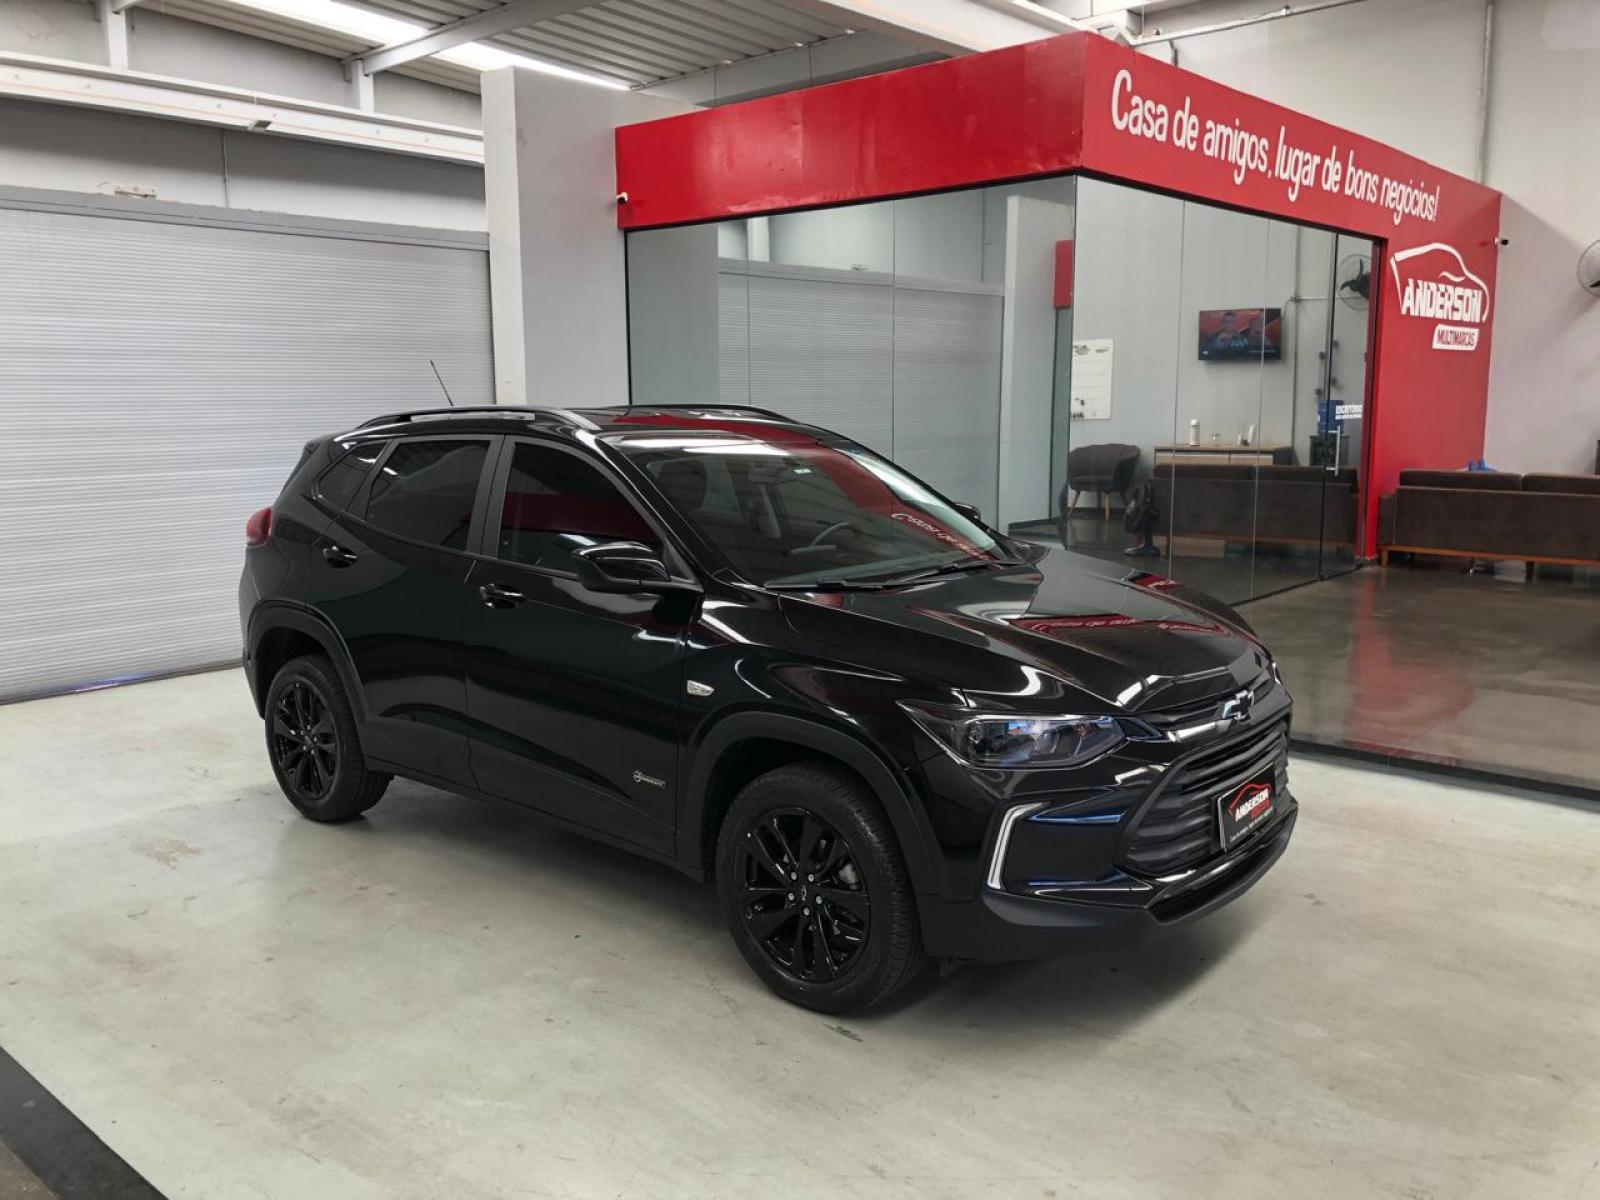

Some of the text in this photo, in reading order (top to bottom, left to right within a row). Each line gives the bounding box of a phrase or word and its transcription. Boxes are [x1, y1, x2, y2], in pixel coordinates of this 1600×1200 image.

[1111, 69, 1440, 226] Casa de amigos, lugar de bons negócios!
[1401, 278, 1482, 323] ANDERSON
[1437, 328, 1476, 347] MULTIMARCAS
